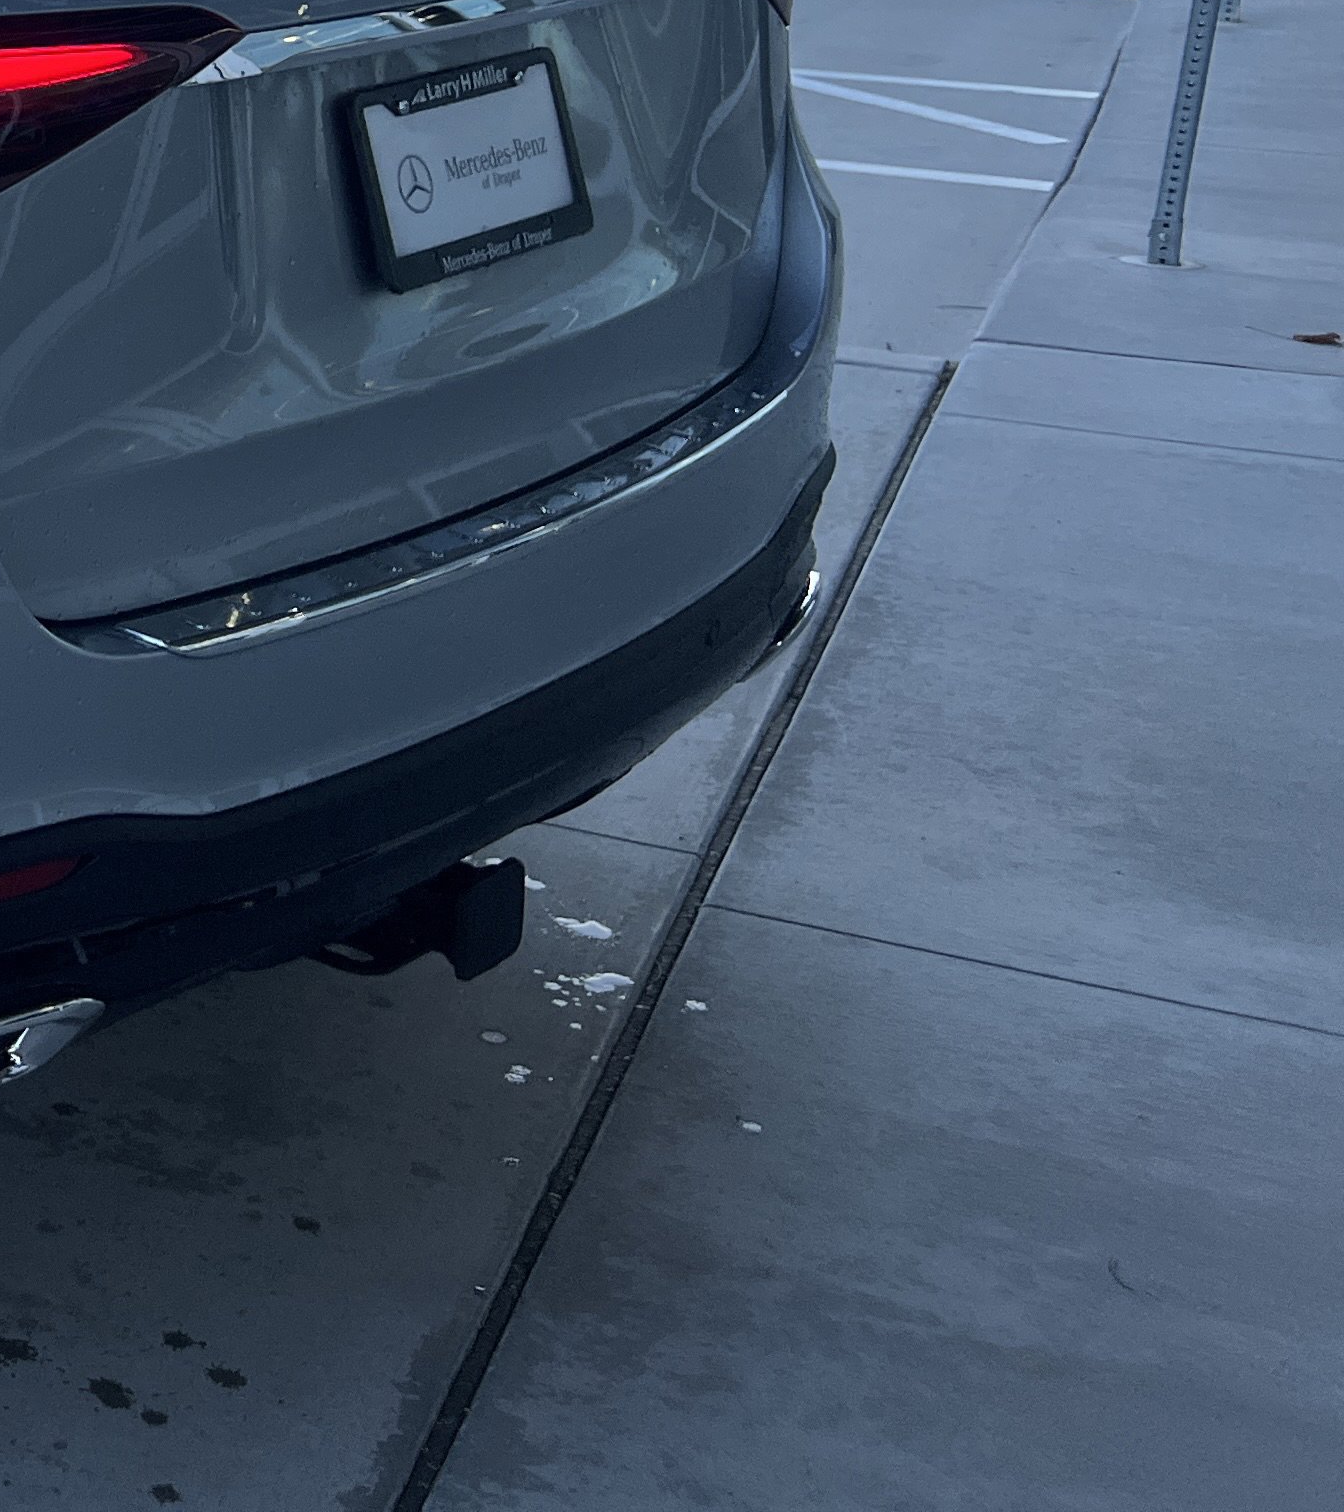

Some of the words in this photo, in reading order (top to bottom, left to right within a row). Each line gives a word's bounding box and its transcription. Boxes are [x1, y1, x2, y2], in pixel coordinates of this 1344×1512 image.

[425, 79, 460, 101] Larry
[472, 64, 508, 90] Miller
[443, 136, 548, 183] Mercedes-Benz
